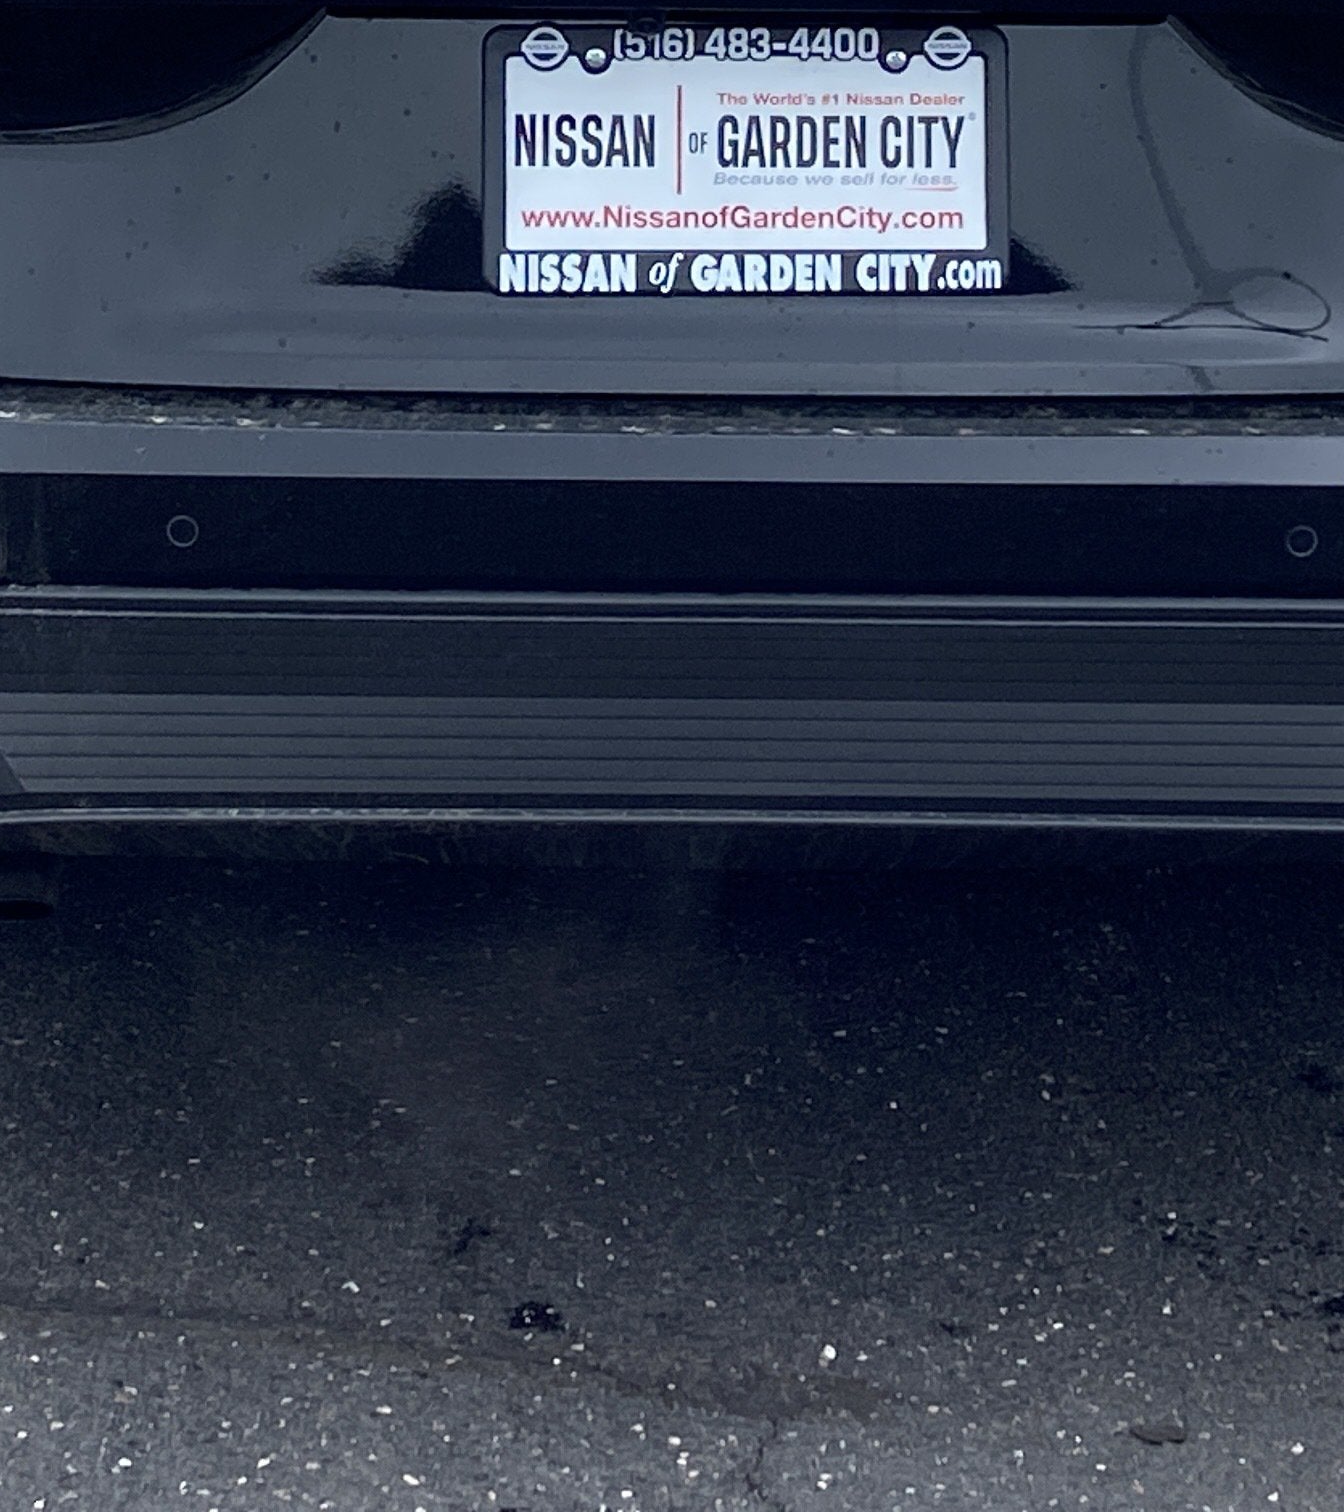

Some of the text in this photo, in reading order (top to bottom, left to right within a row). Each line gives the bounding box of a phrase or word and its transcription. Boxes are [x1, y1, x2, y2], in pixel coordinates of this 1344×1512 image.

[613, 27, 879, 61] (516) 483-4400
[717, 92, 965, 106] The World's #1 Nissan Dealer
[514, 113, 965, 169] NISSAN OF GARDEN CITY
[713, 171, 798, 187] Because
[804, 173, 834, 187] we
[840, 171, 874, 187] sell
[880, 171, 907, 187] for
[521, 205, 964, 234] www.NissanofGardenCity.com
[498, 251, 1003, 294] NISSAN of GARDEN CITY.com
